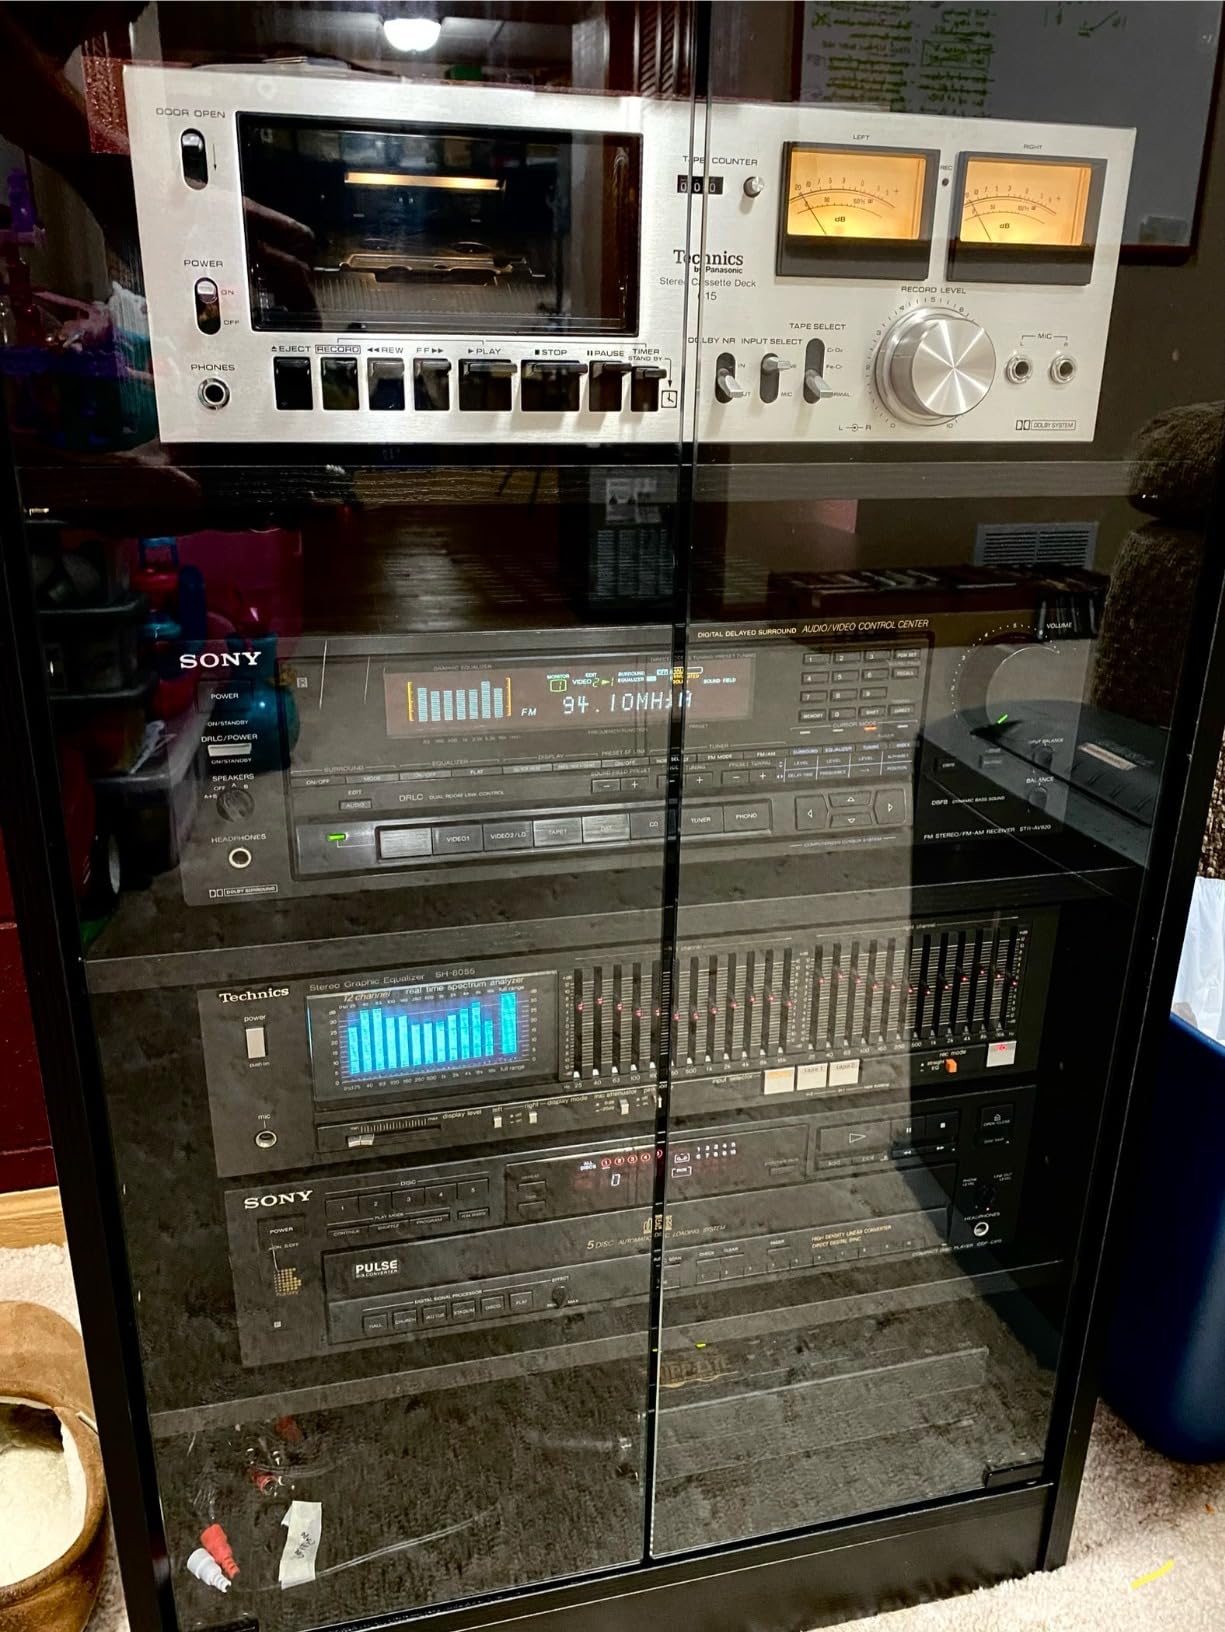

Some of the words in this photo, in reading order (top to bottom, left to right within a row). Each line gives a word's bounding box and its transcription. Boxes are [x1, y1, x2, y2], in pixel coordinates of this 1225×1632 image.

[156, 107, 190, 118] DOOR
[193, 109, 226, 119] OPEN
[682, 155, 705, 164] TPE
[711, 157, 758, 166] COUNTER
[183, 259, 224, 268] POWER
[705, 266, 743, 275] Panasonic
[691, 278, 732, 287] Cssette
[735, 279, 757, 288] Deck
[221, 288, 235, 297] ON
[901, 286, 938, 294] RECORD
[940, 287, 967, 295] LEVEL
[697, 291, 718, 301] 15
[813, 323, 847, 331] SELECT
[722, 337, 736, 345] NR
[769, 338, 803, 346] SELECT
[279, 345, 312, 353] EJECT
[316, 345, 361, 353] RECORD
[541, 348, 568, 356] STOP
[594, 349, 625, 357] PAUSE
[190, 362, 235, 372] PHONES
[801, 622, 857, 634] AUDIO/VIDEO
[858, 620, 896, 631] CONTROL
[897, 618, 929, 630] CENTER
[1046, 622, 1073, 630] VOLUME
[697, 630, 724, 639] DIGITAL
[725, 629, 757, 638] DELAYED
[757, 627, 798, 637] SURROUND
[179, 651, 262, 669] SONY
[210, 692, 239, 700] POWER
[521, 707, 538, 717] FM
[201, 733, 258, 743] DRLC/POWER
[212, 773, 255, 782] SPEAKERS
[399, 793, 424, 802] DRLC
[690, 816, 711, 824] TUNER
[735, 812, 758, 820] PHONO
[211, 834, 267, 843] HEADPHONES
[309, 983, 341, 992] Stereo
[343, 978, 381, 990] Graphic
[383, 973, 426, 984] Equalizer
[405, 986, 423, 995] real
[425, 984, 444, 993] time
[447, 980, 488, 992] spectrum
[490, 975, 525, 988] analyzer
[218, 987, 290, 1003] Technics
[354, 990, 392, 1002] channel
[243, 1013, 267, 1024] power
[258, 1113, 271, 1121] mic
[442, 1111, 467, 1122] display
[467, 1107, 483, 1119] level
[400, 1179, 417, 1187] DISC
[244, 1190, 313, 1210] SONY
[269, 1226, 294, 1235] POWER
[586, 1239, 595, 1250] 5
[355, 1259, 398, 1274] PULSE
